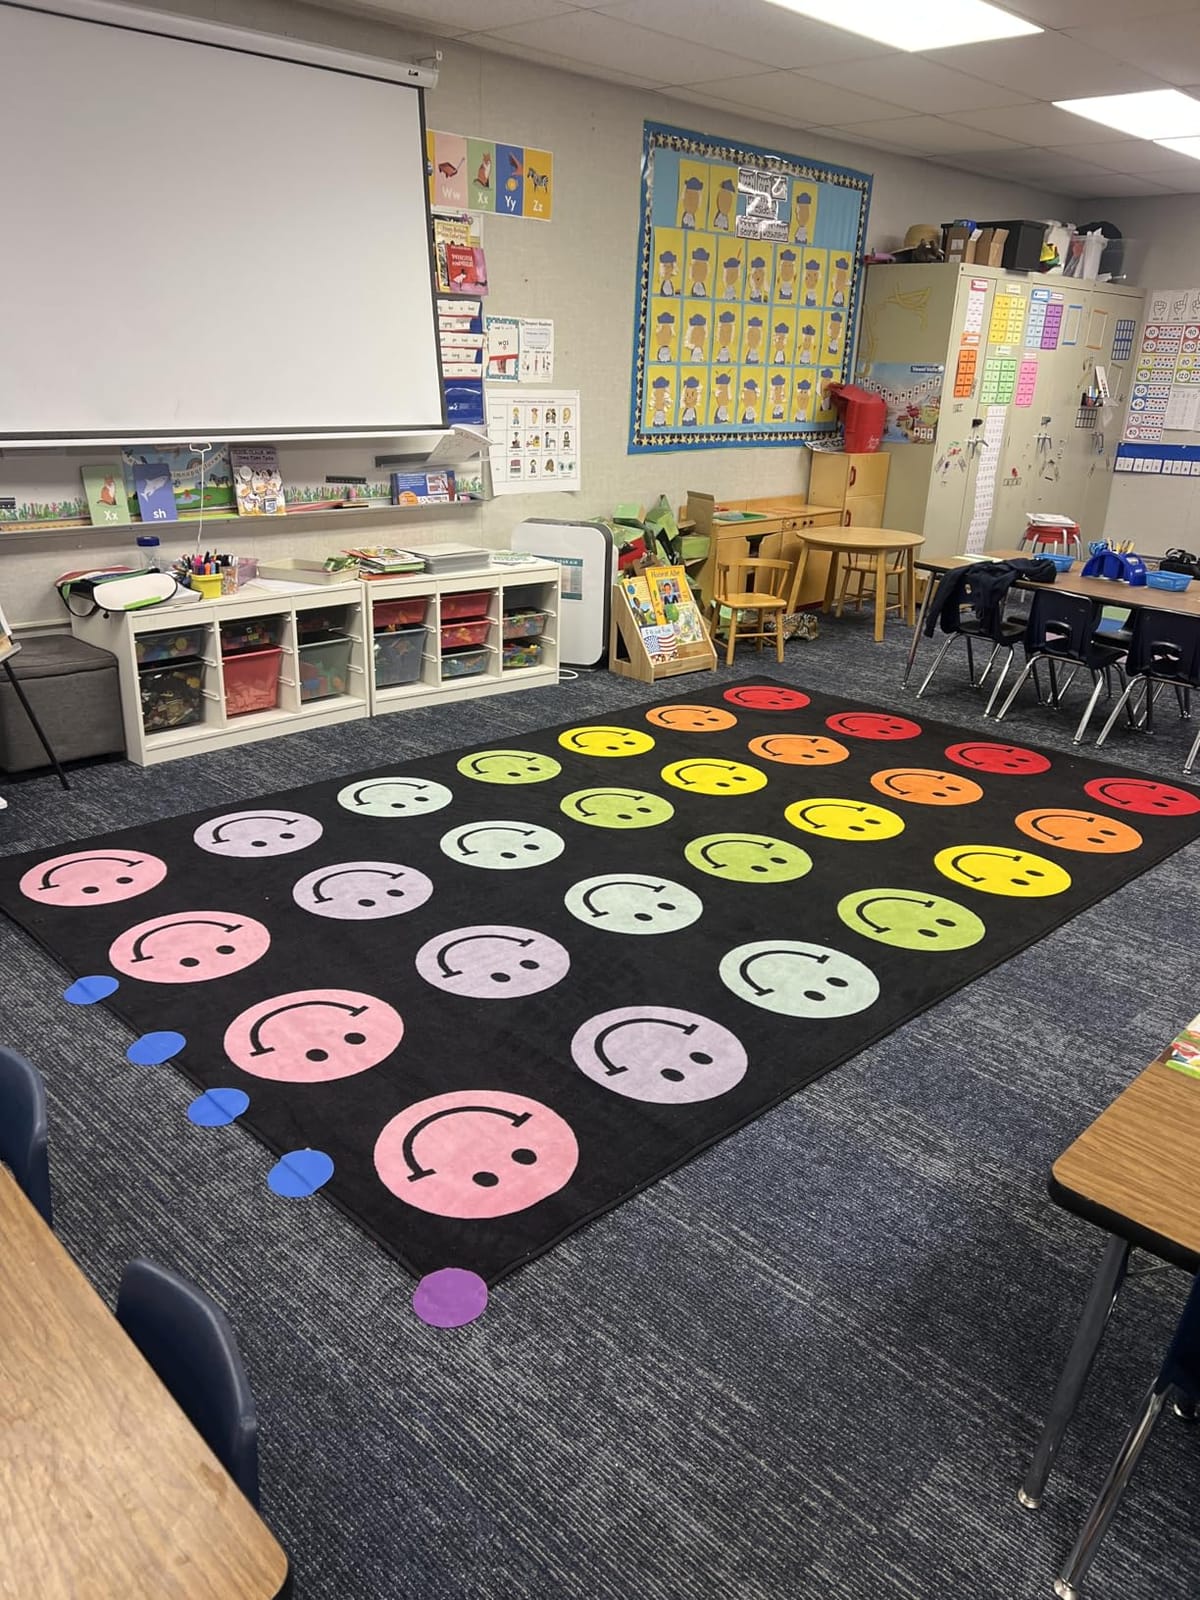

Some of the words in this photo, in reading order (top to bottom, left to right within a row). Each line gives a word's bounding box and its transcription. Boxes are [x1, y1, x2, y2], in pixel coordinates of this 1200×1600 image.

[442, 186, 460, 200] Ww
[478, 191, 489, 204] Xx
[504, 195, 517, 212] Yy
[532, 199, 543, 212] Zz
[104, 510, 118, 521] Xx
[153, 508, 167, 519] sh
